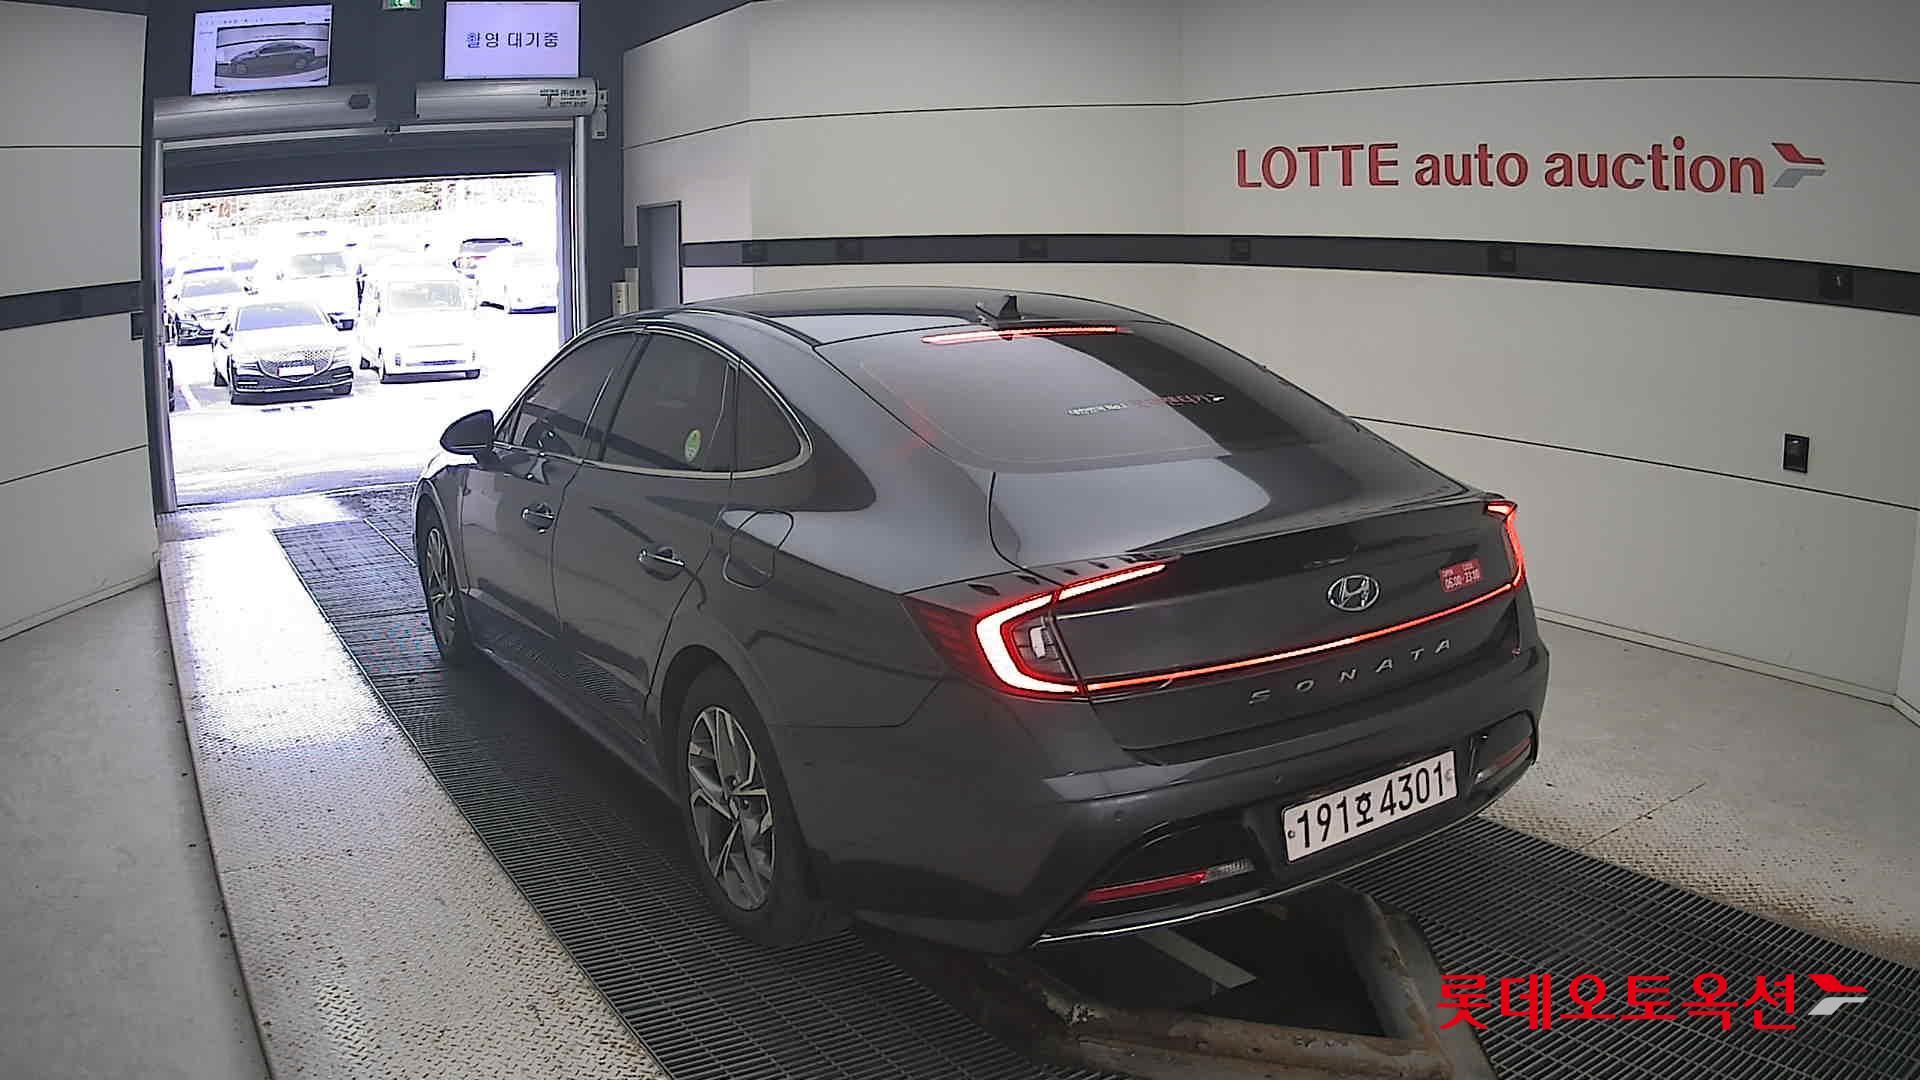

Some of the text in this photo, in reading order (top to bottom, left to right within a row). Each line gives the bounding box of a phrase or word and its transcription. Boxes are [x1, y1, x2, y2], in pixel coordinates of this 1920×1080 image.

[507, 32, 559, 48] 대기중
[1236, 137, 1765, 194] LOTTE auto auction
[1249, 639, 1451, 705] SONATA
